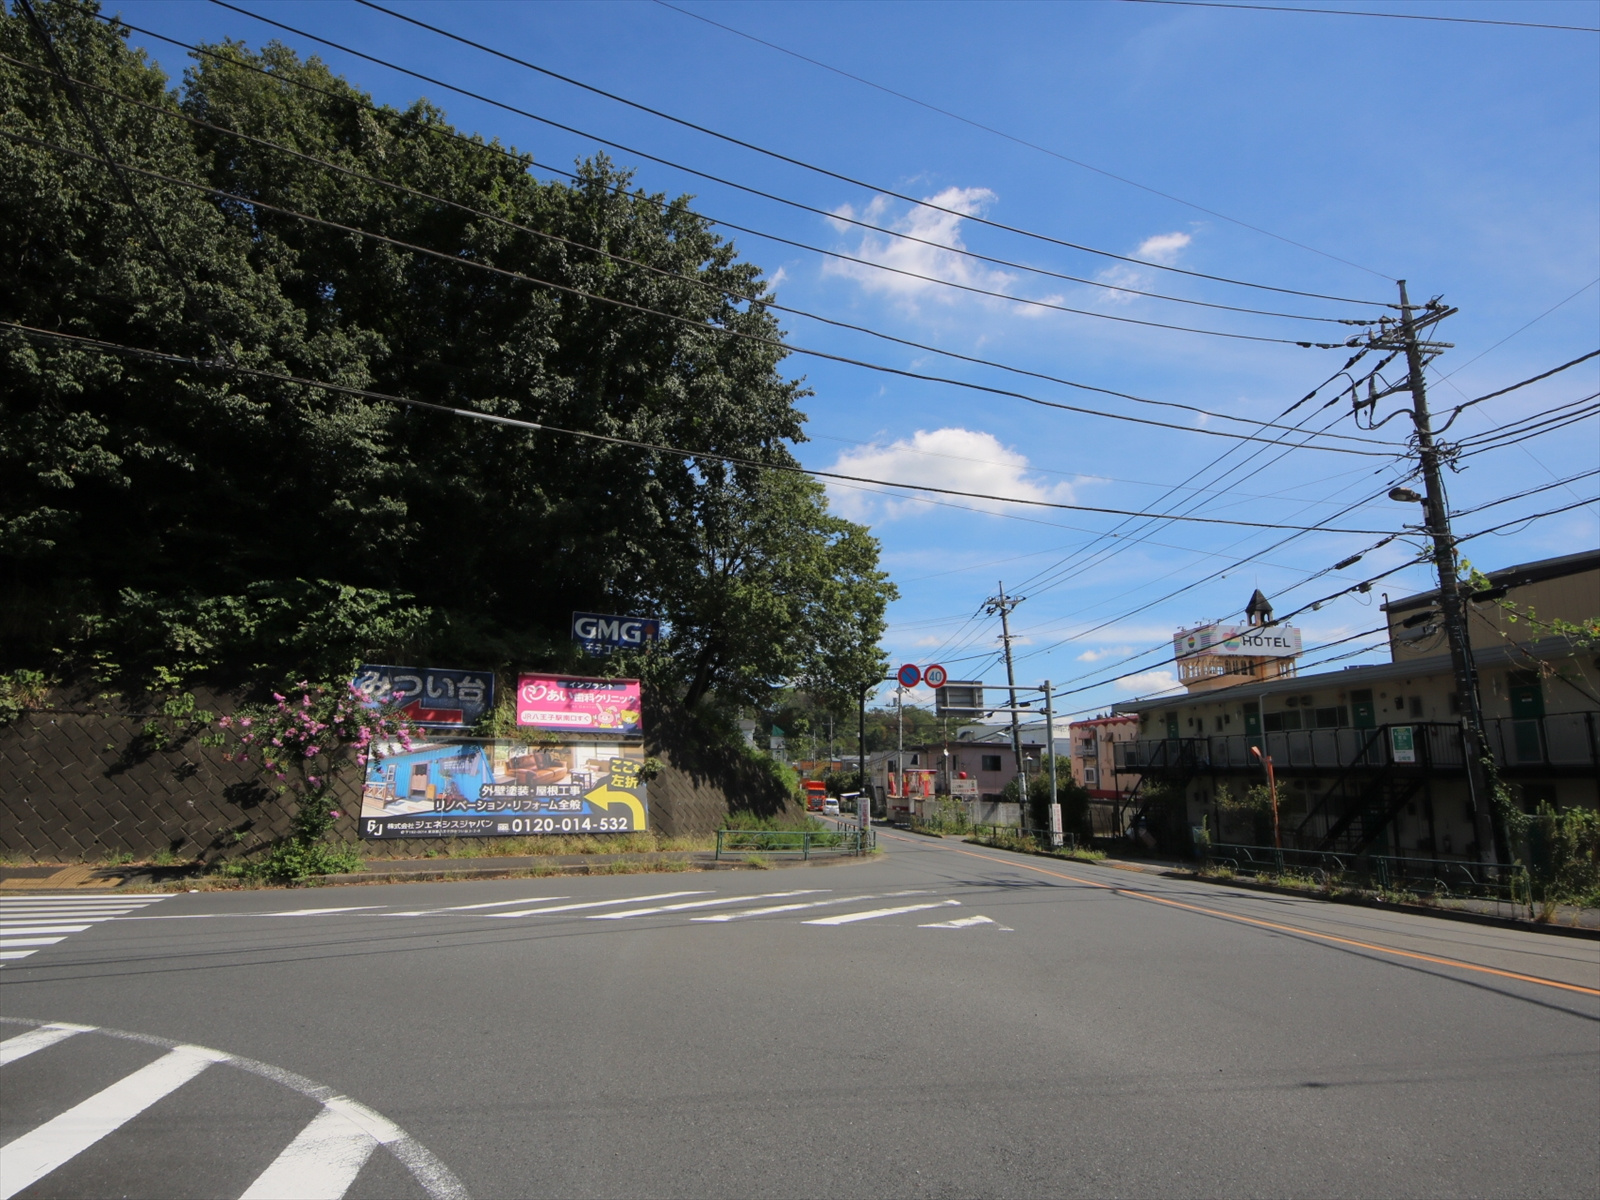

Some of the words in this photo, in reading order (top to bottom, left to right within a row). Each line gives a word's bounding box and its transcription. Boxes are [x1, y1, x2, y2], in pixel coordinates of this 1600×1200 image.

[575, 617, 642, 643] GMG
[1242, 636, 1291, 648] HOTEL
[928, 671, 941, 682] 40
[360, 671, 486, 703] みつい台
[569, 681, 615, 690] インプラント
[546, 689, 636, 704] あい歯科クリニック
[522, 712, 590, 722] JR八王子駅南口すぐ
[610, 774, 639, 789] 左折
[481, 784, 581, 797] 外壁塗装・屋根工事
[435, 799, 581, 812] リノベーション・リフォーム全般
[511, 816, 628, 833] 0120-014-532
